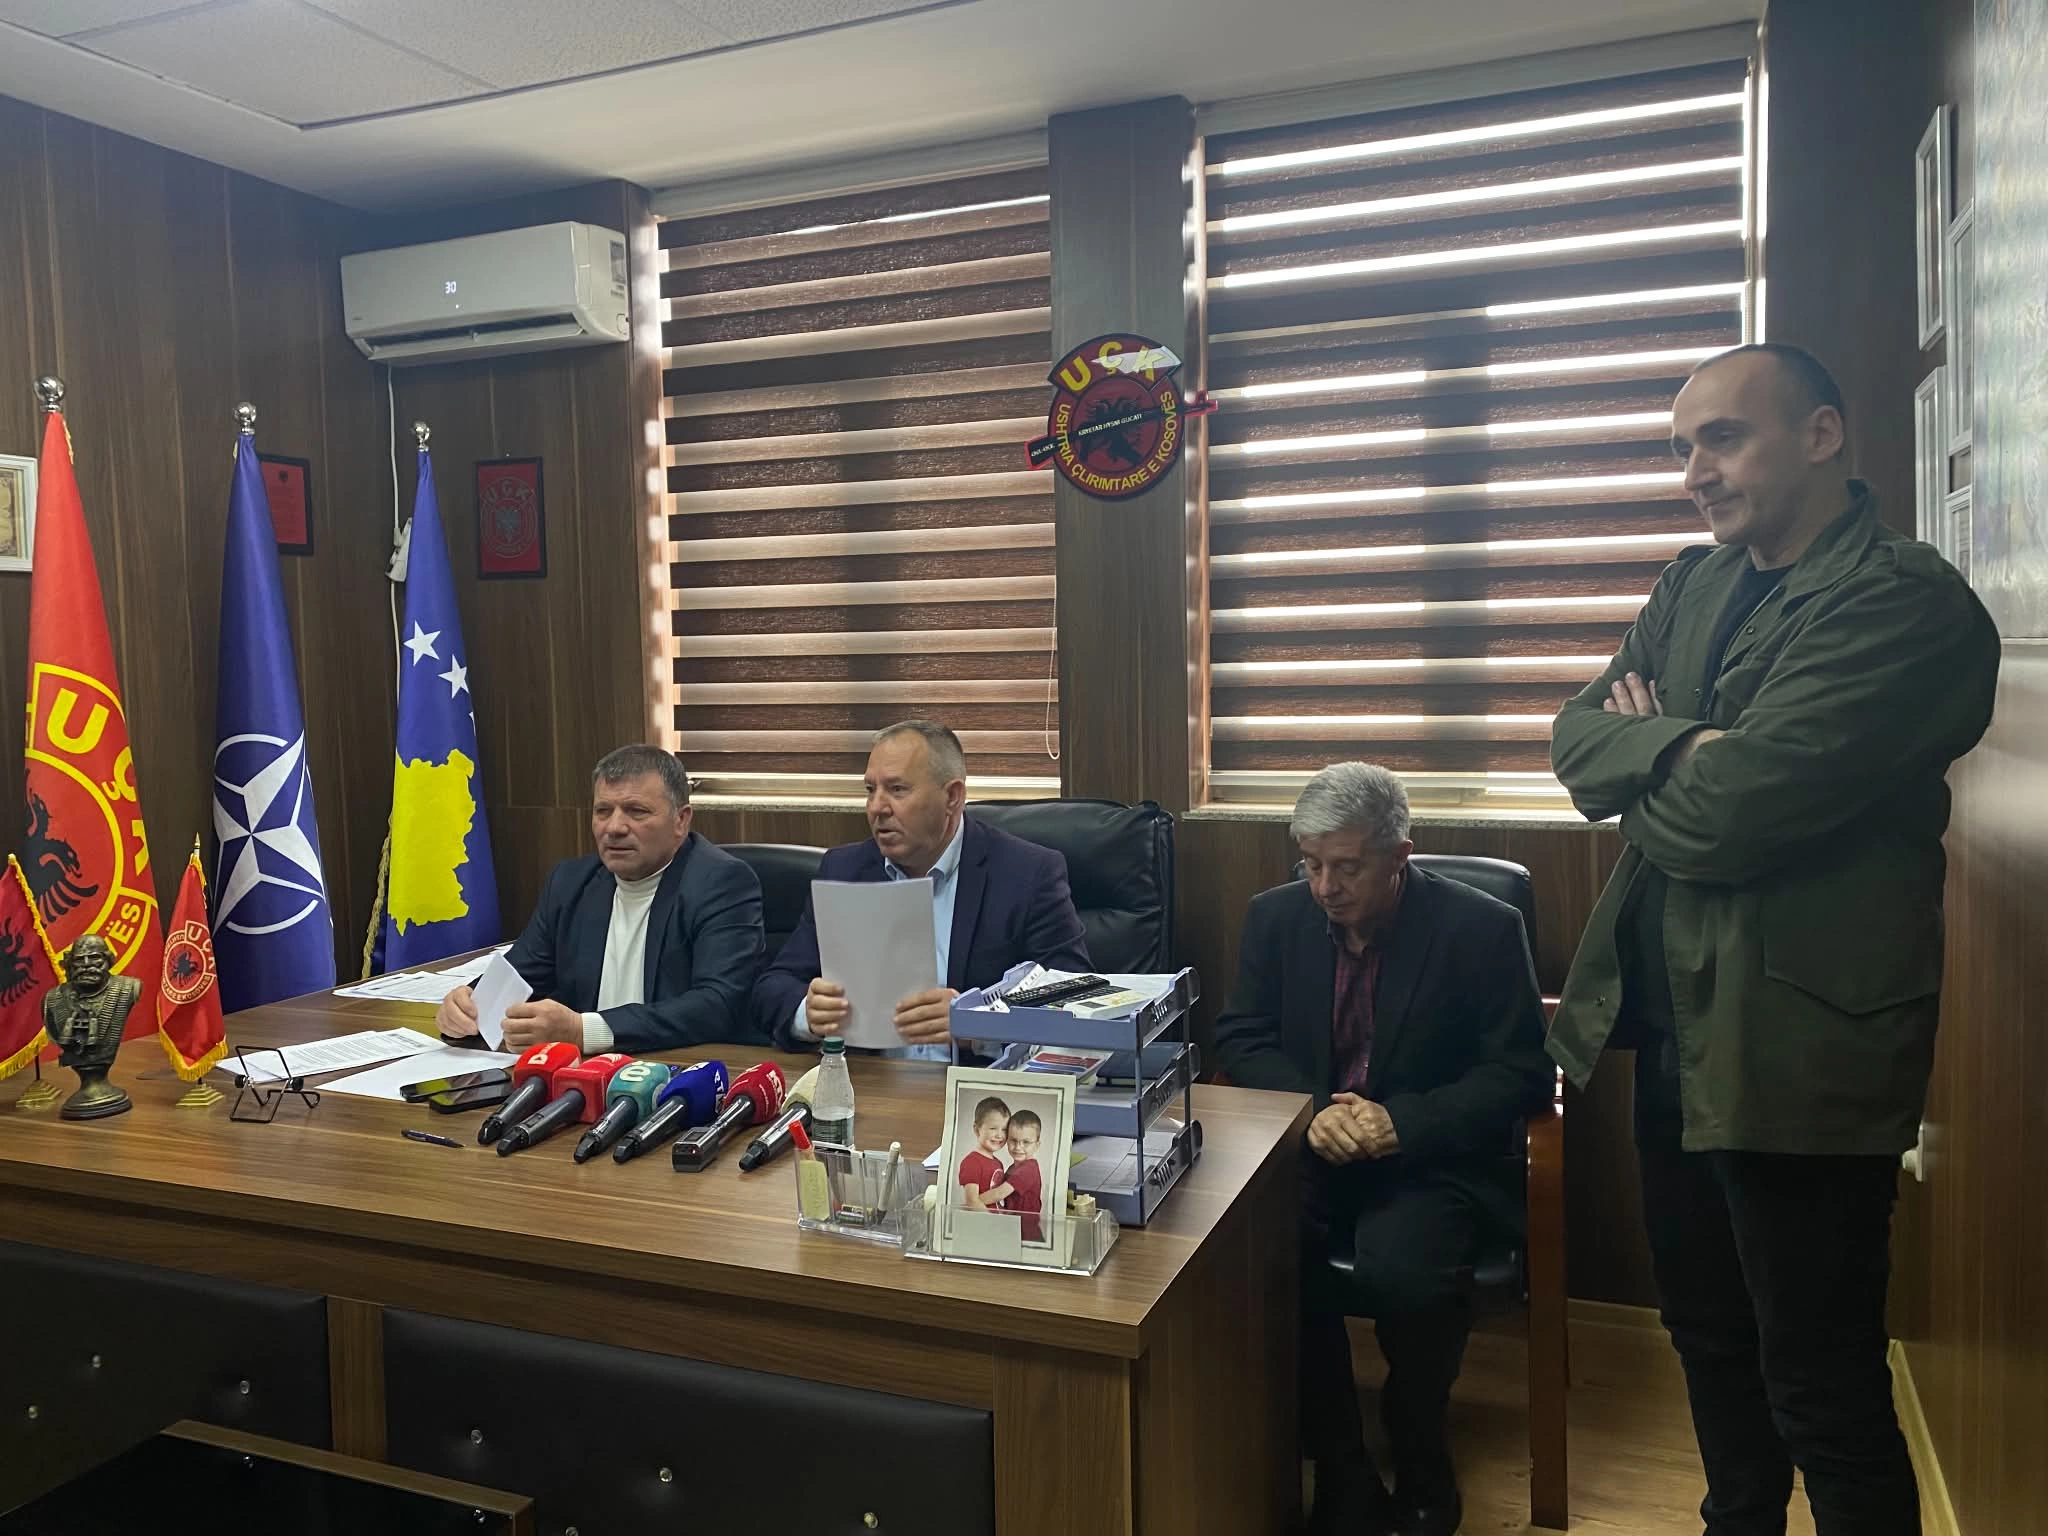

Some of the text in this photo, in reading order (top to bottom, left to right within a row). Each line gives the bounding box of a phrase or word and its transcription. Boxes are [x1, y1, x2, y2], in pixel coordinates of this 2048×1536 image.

[444, 280, 457, 294] 30
[1060, 342, 1164, 391] UÇK
[1056, 391, 1177, 491] USHTRIA ÇLIRIMTARE E KOSOVËS
